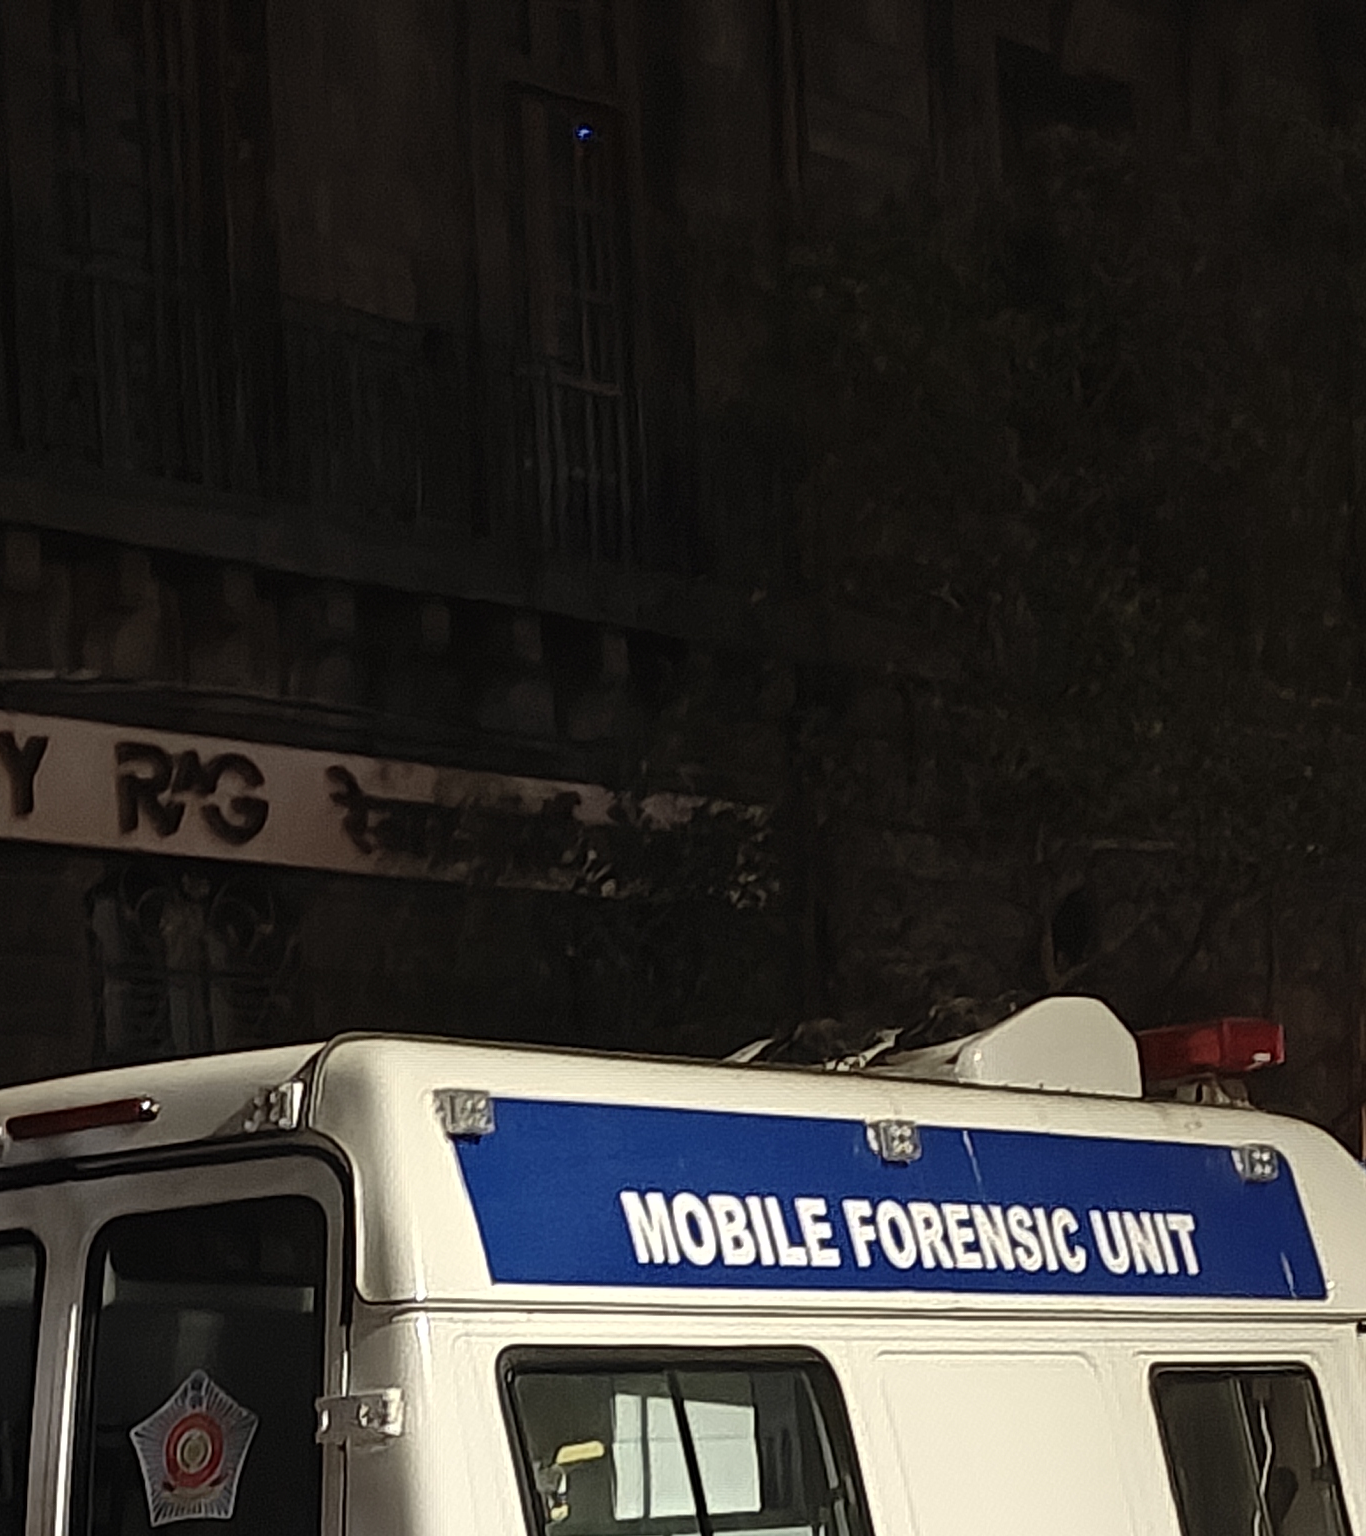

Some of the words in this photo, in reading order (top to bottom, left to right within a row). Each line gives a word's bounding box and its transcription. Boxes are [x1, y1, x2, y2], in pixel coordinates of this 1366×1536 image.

[621, 1190, 840, 1269] MOBILE
[844, 1198, 1088, 1275] FORENSIC
[1091, 1209, 1200, 1276] UNIT
